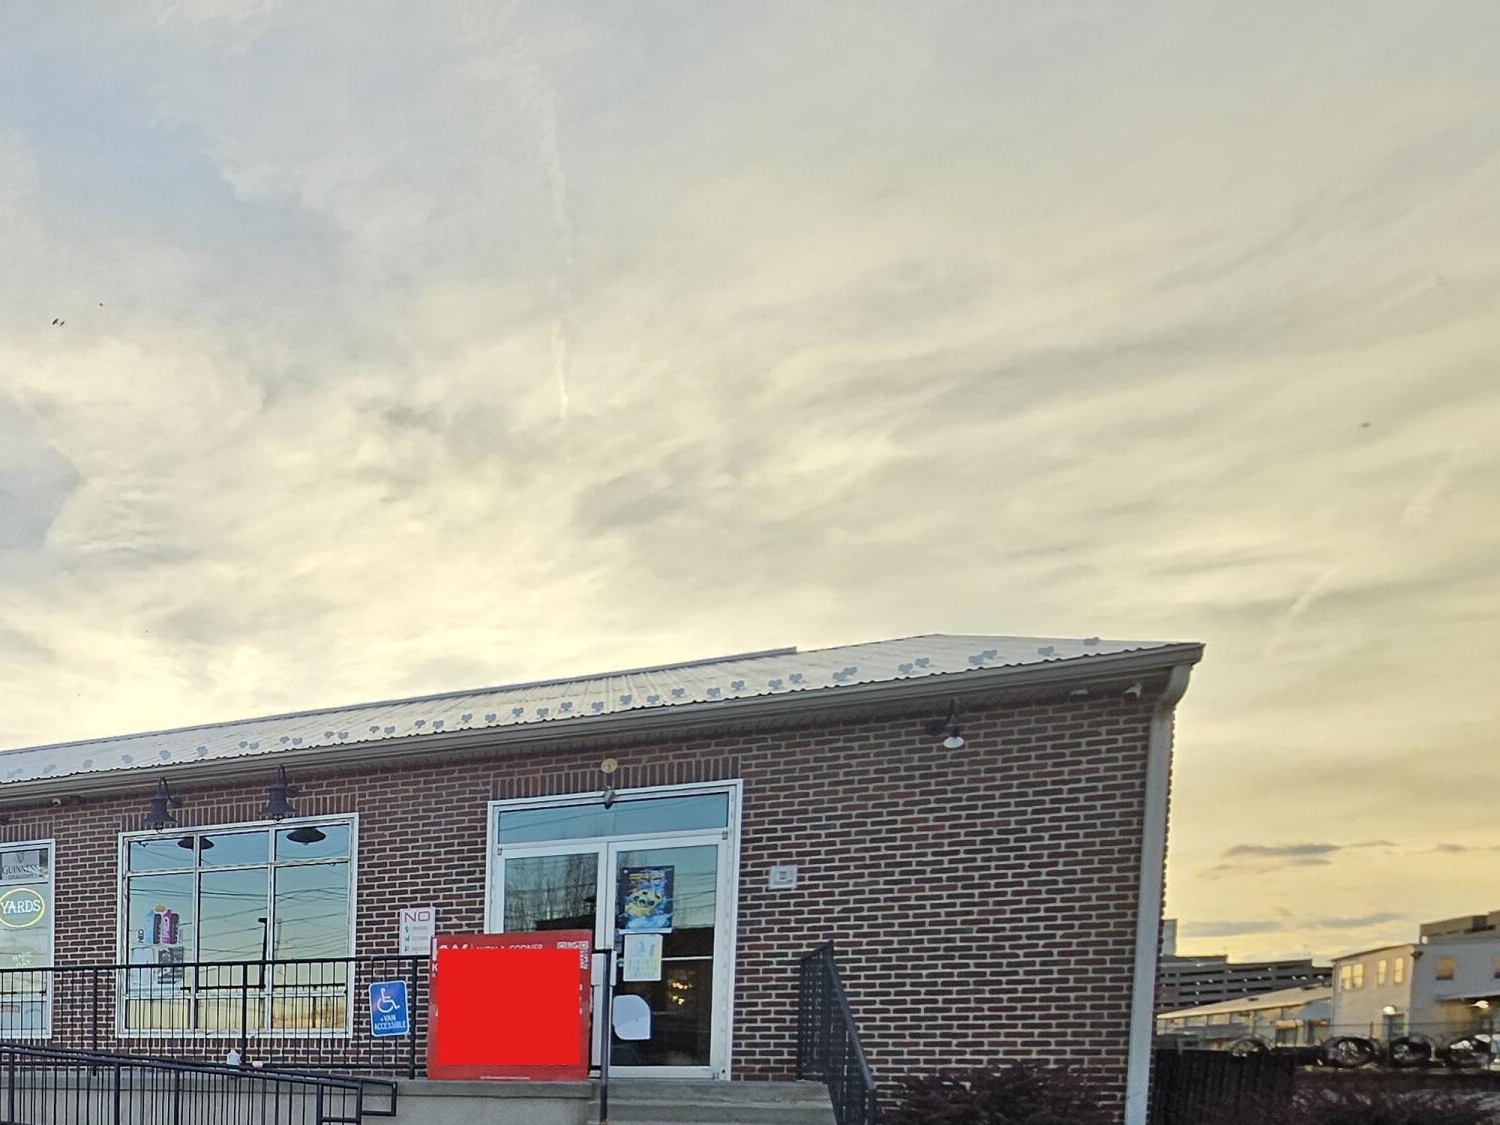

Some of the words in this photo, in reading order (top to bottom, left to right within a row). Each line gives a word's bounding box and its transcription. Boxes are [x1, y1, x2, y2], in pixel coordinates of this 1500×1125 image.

[1, 900, 41, 914] YARDS
[404, 911, 431, 922] NO
[374, 1020, 406, 1031] ACCESSIBLE
